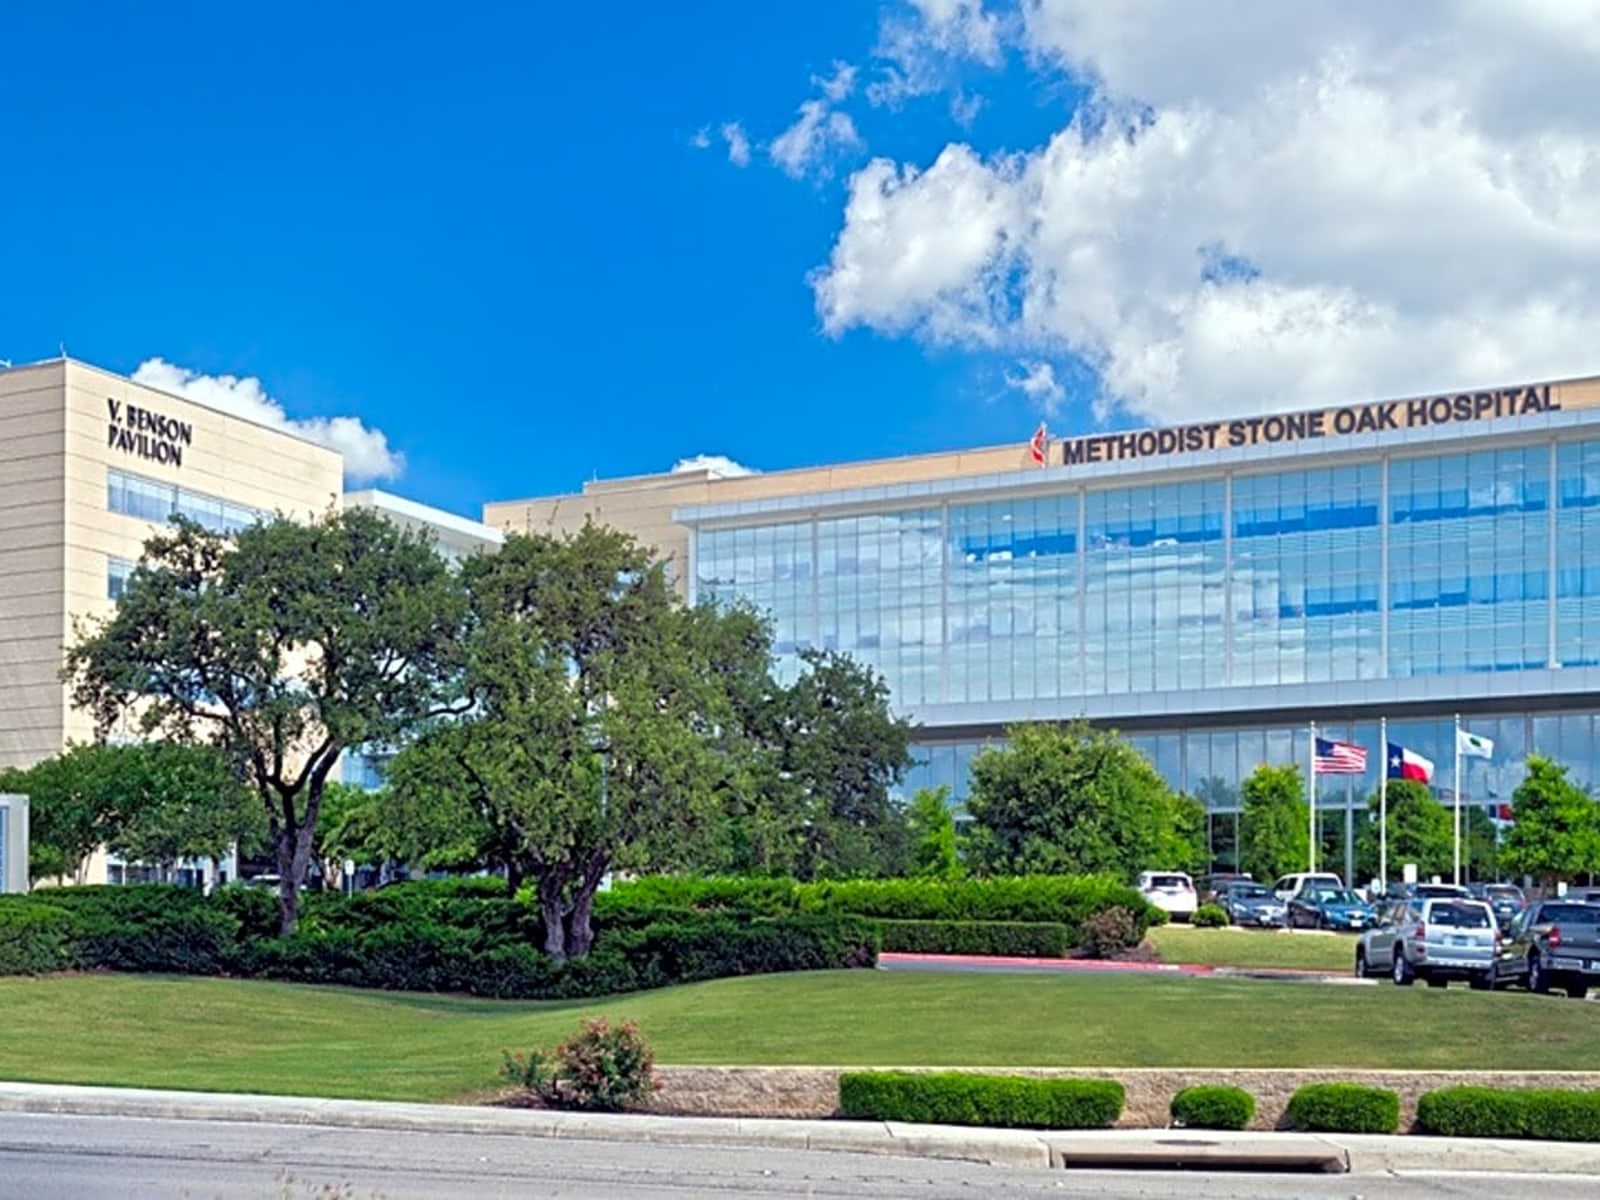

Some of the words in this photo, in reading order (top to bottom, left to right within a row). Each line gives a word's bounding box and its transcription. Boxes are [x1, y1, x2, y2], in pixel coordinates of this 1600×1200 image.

[107, 424, 182, 467] PAVILION
[126, 404, 192, 447] BENSON
[1062, 425, 1219, 465] METHODIST
[1228, 411, 1325, 446] STONE
[1334, 403, 1399, 434] OAK
[1406, 384, 1561, 427] HOSPITAL
